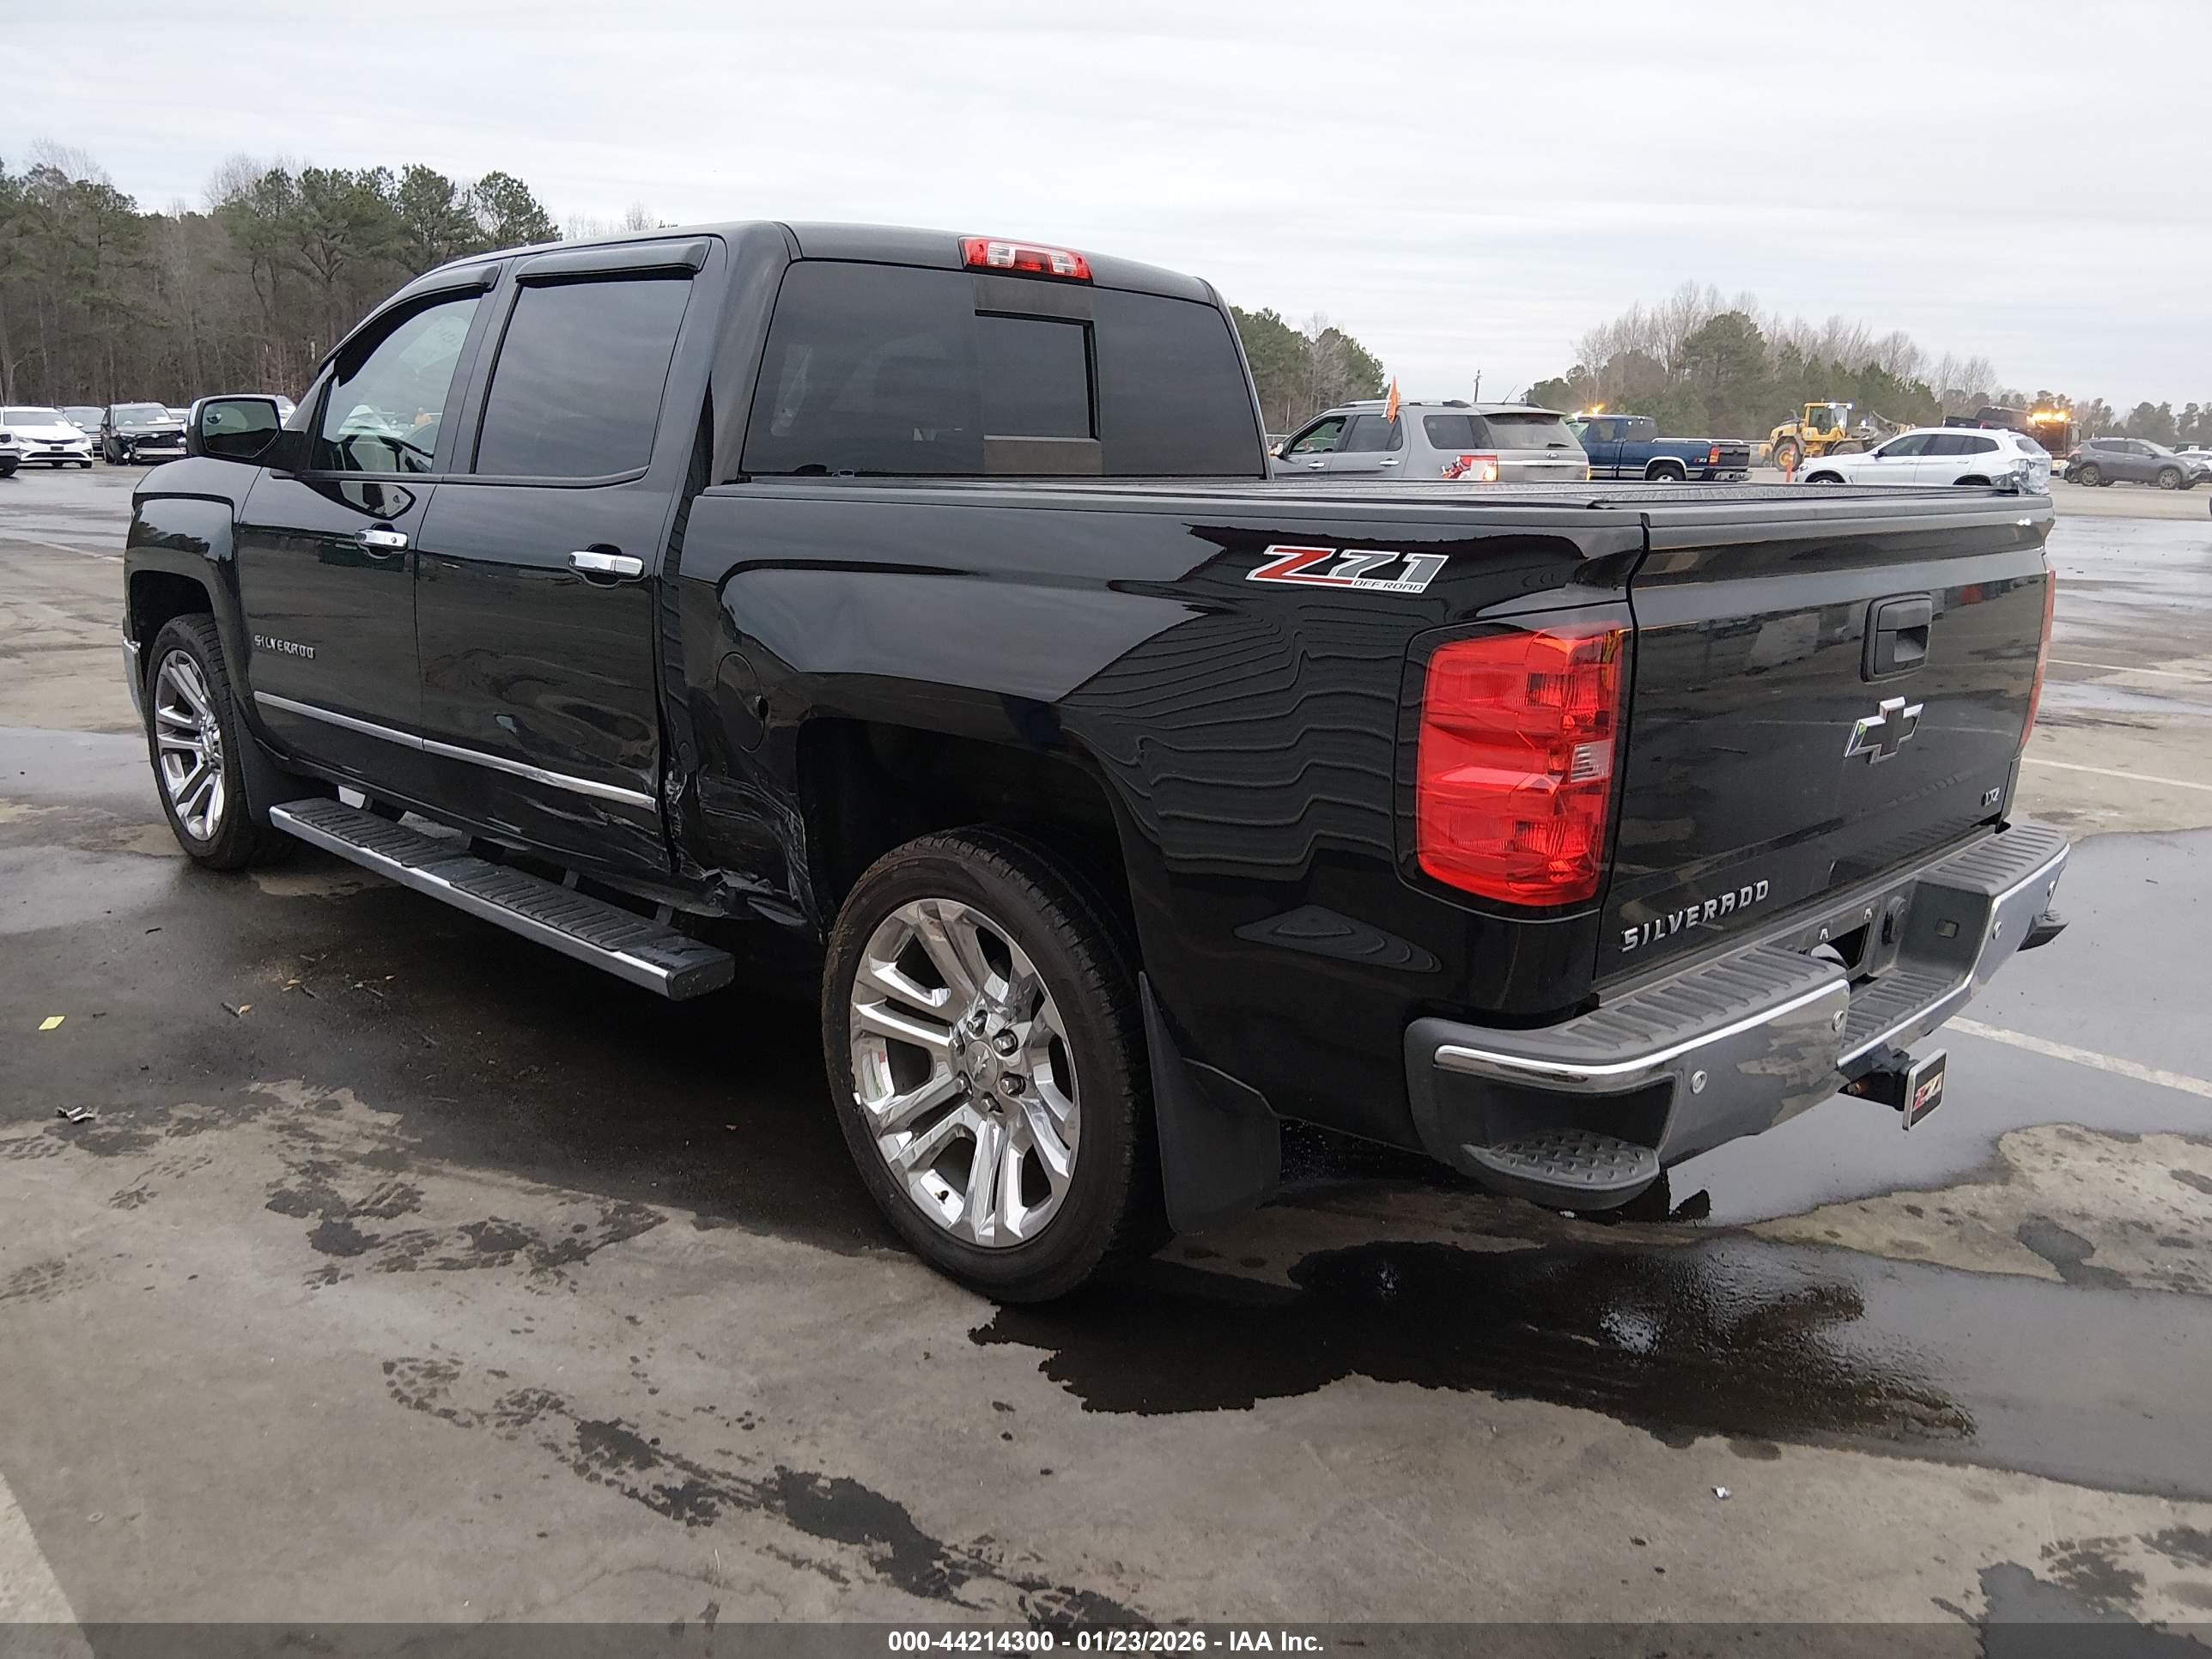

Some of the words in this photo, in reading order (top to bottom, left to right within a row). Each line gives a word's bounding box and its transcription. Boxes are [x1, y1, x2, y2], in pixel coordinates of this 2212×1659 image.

[1245, 544, 1449, 587] Z71
[1353, 579, 1382, 587] OFF
[1382, 581, 1424, 592] ROAD
[254, 635, 314, 659] SILVERADO
[1620, 879, 1770, 953] SILVERADO
